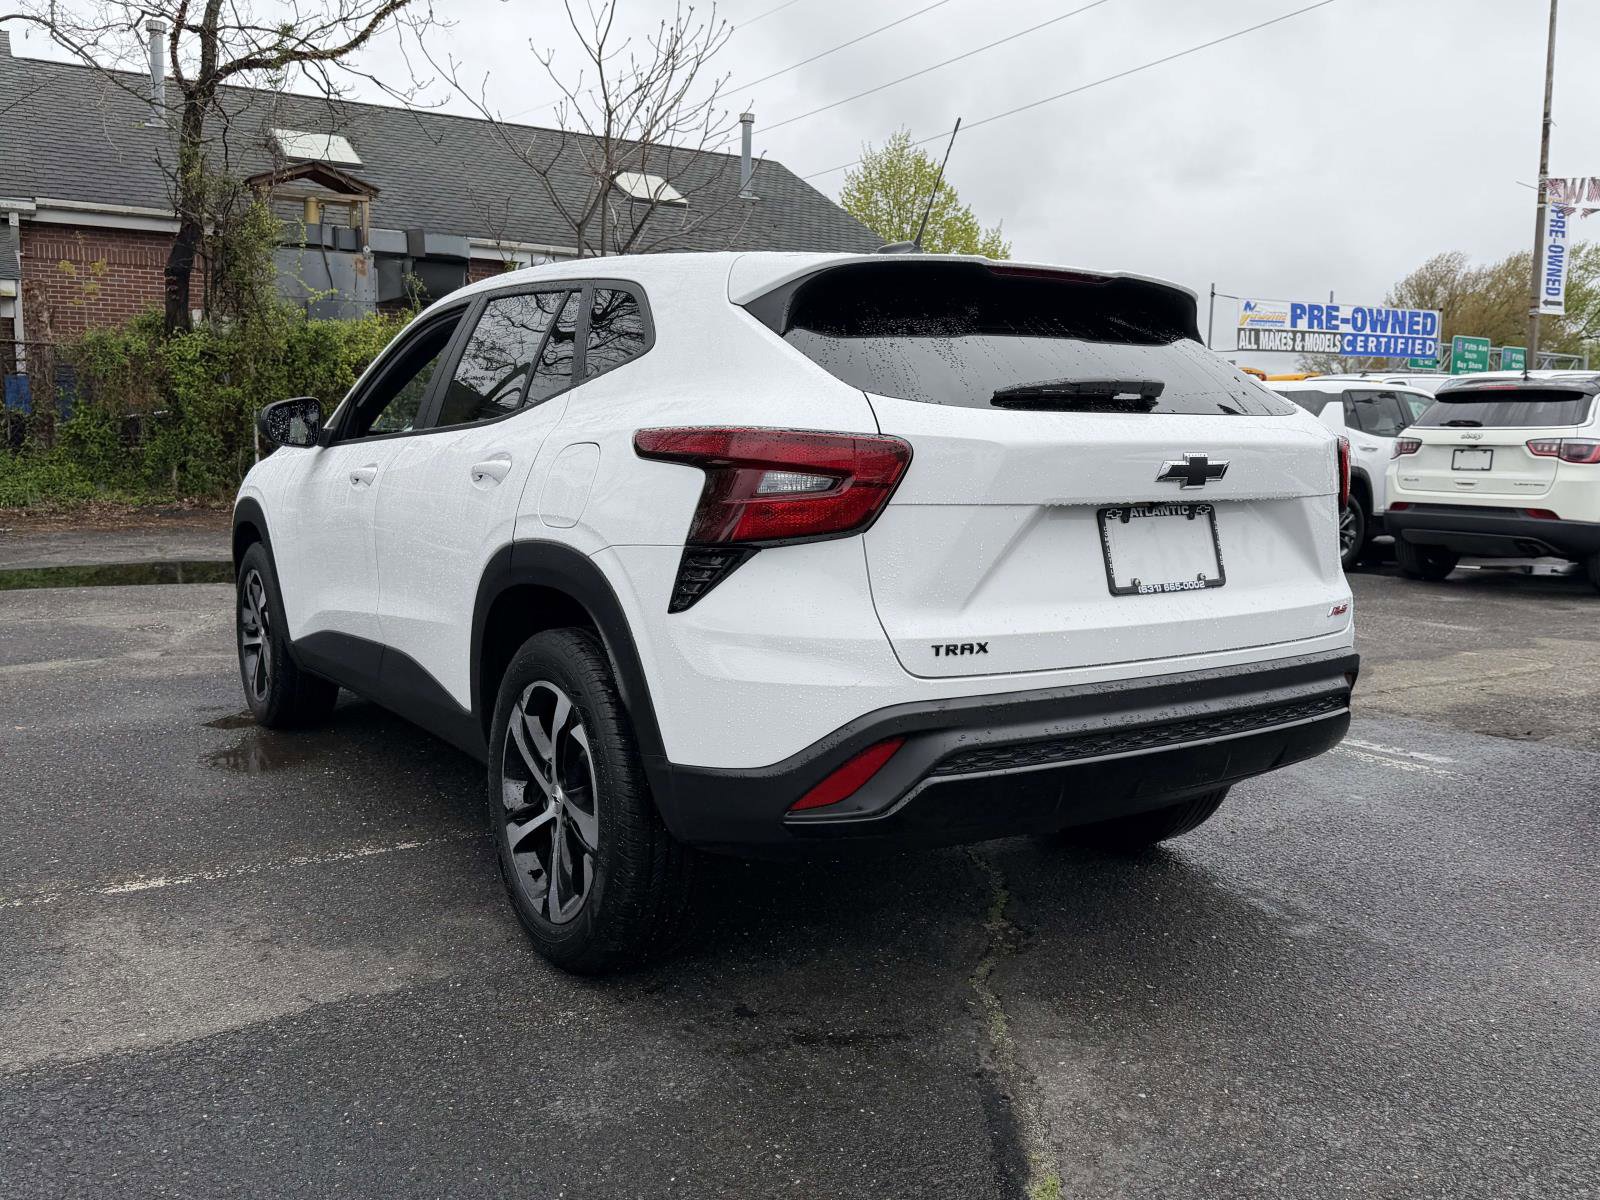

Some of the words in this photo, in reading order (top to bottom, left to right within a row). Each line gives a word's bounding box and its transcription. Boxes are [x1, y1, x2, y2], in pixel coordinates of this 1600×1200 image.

[1546, 208, 1566, 297] PRE-OWNED
[1290, 303, 1437, 336] PRE-OWNED
[1238, 329, 1257, 350] ALL
[1259, 331, 1293, 351] MAKES
[1294, 333, 1304, 351] &
[1304, 334, 1341, 353] MODELS
[1343, 336, 1435, 355] CERTIFIED
[1129, 505, 1190, 518] ATLANTIC
[931, 641, 989, 657] TRAX
